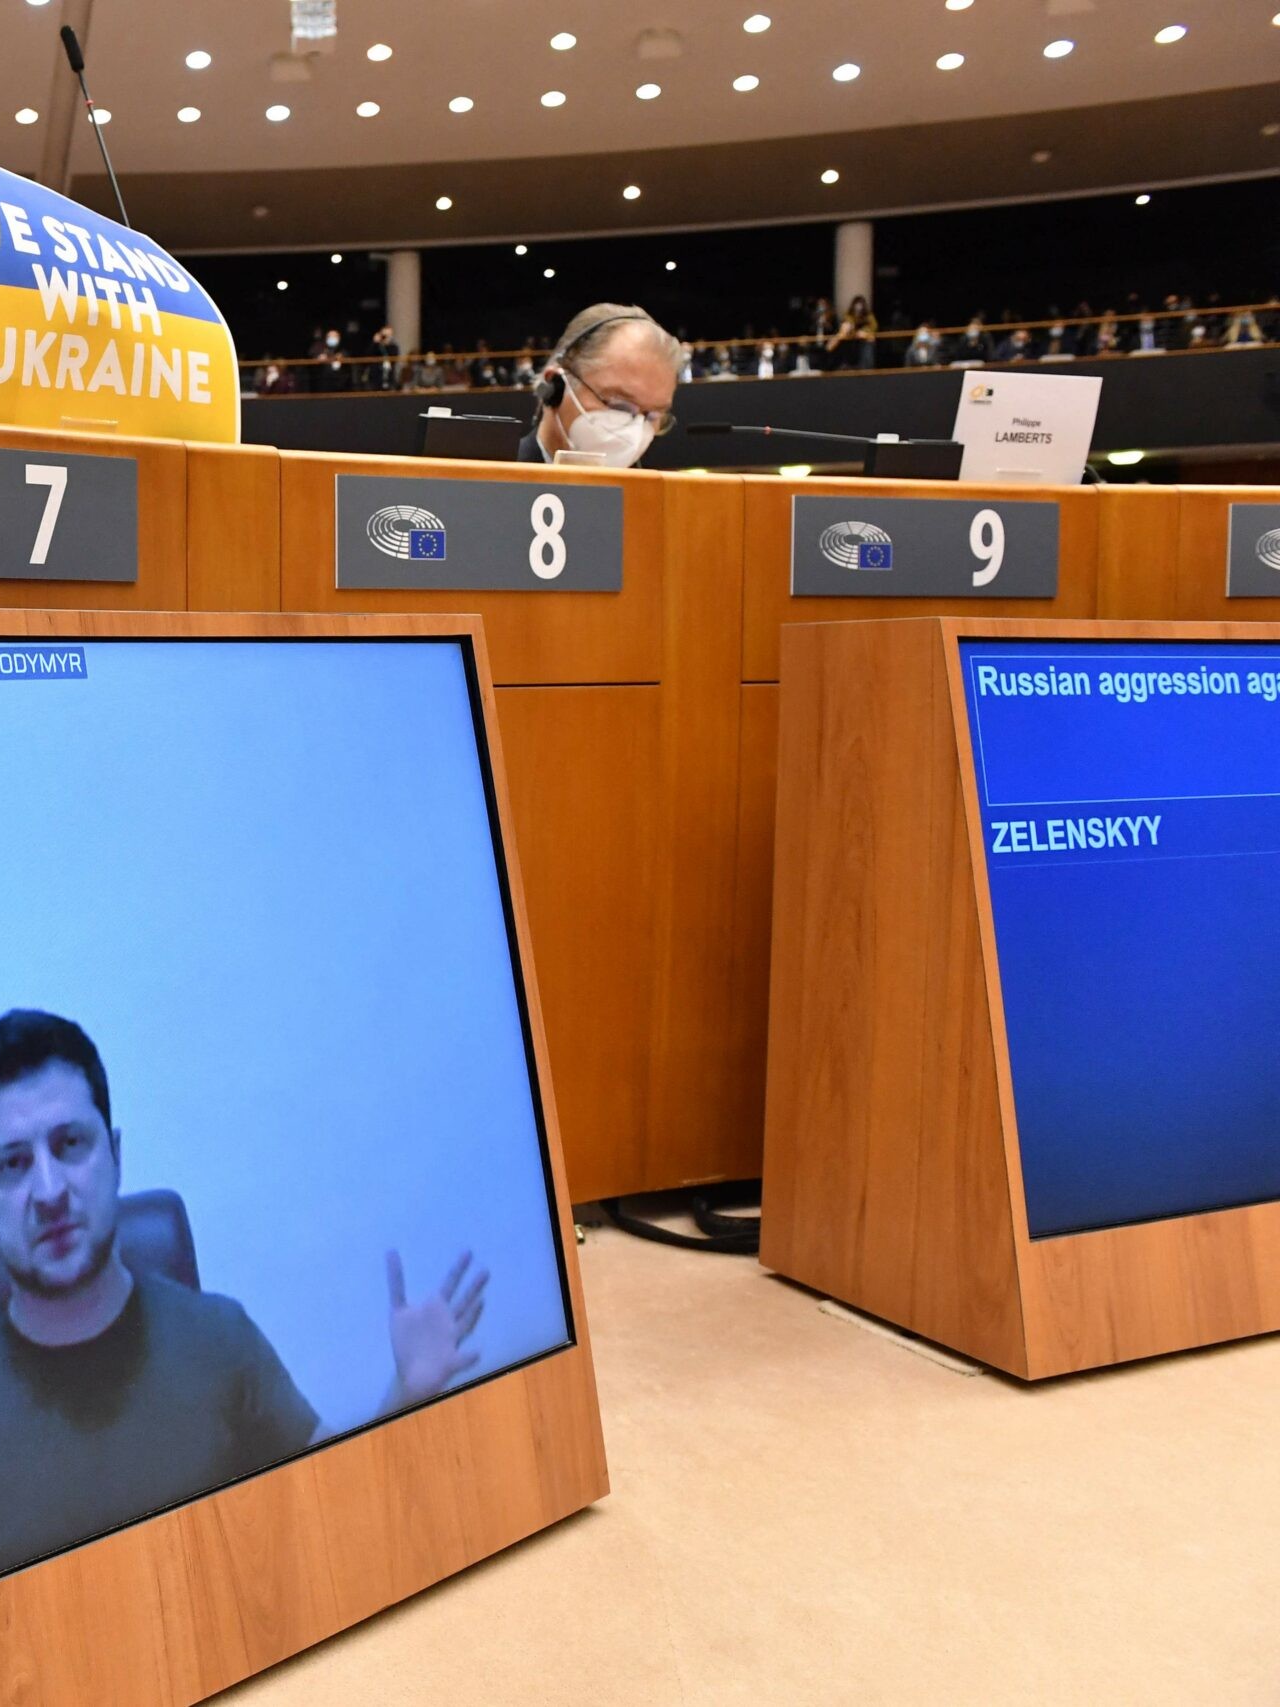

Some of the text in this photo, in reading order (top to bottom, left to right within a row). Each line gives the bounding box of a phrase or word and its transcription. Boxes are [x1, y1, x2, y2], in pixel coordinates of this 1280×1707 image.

[42, 215, 191, 293] STAND
[32, 263, 163, 336] WITH
[995, 432, 1052, 444] LAMBERTS
[1012, 417, 1041, 428] Philippe
[25, 463, 68, 564] 7
[529, 492, 567, 580] 8
[969, 508, 1005, 587] 9
[977, 665, 1280, 703] Russian aggression ag
[991, 815, 1162, 854] ZELENSKYY
